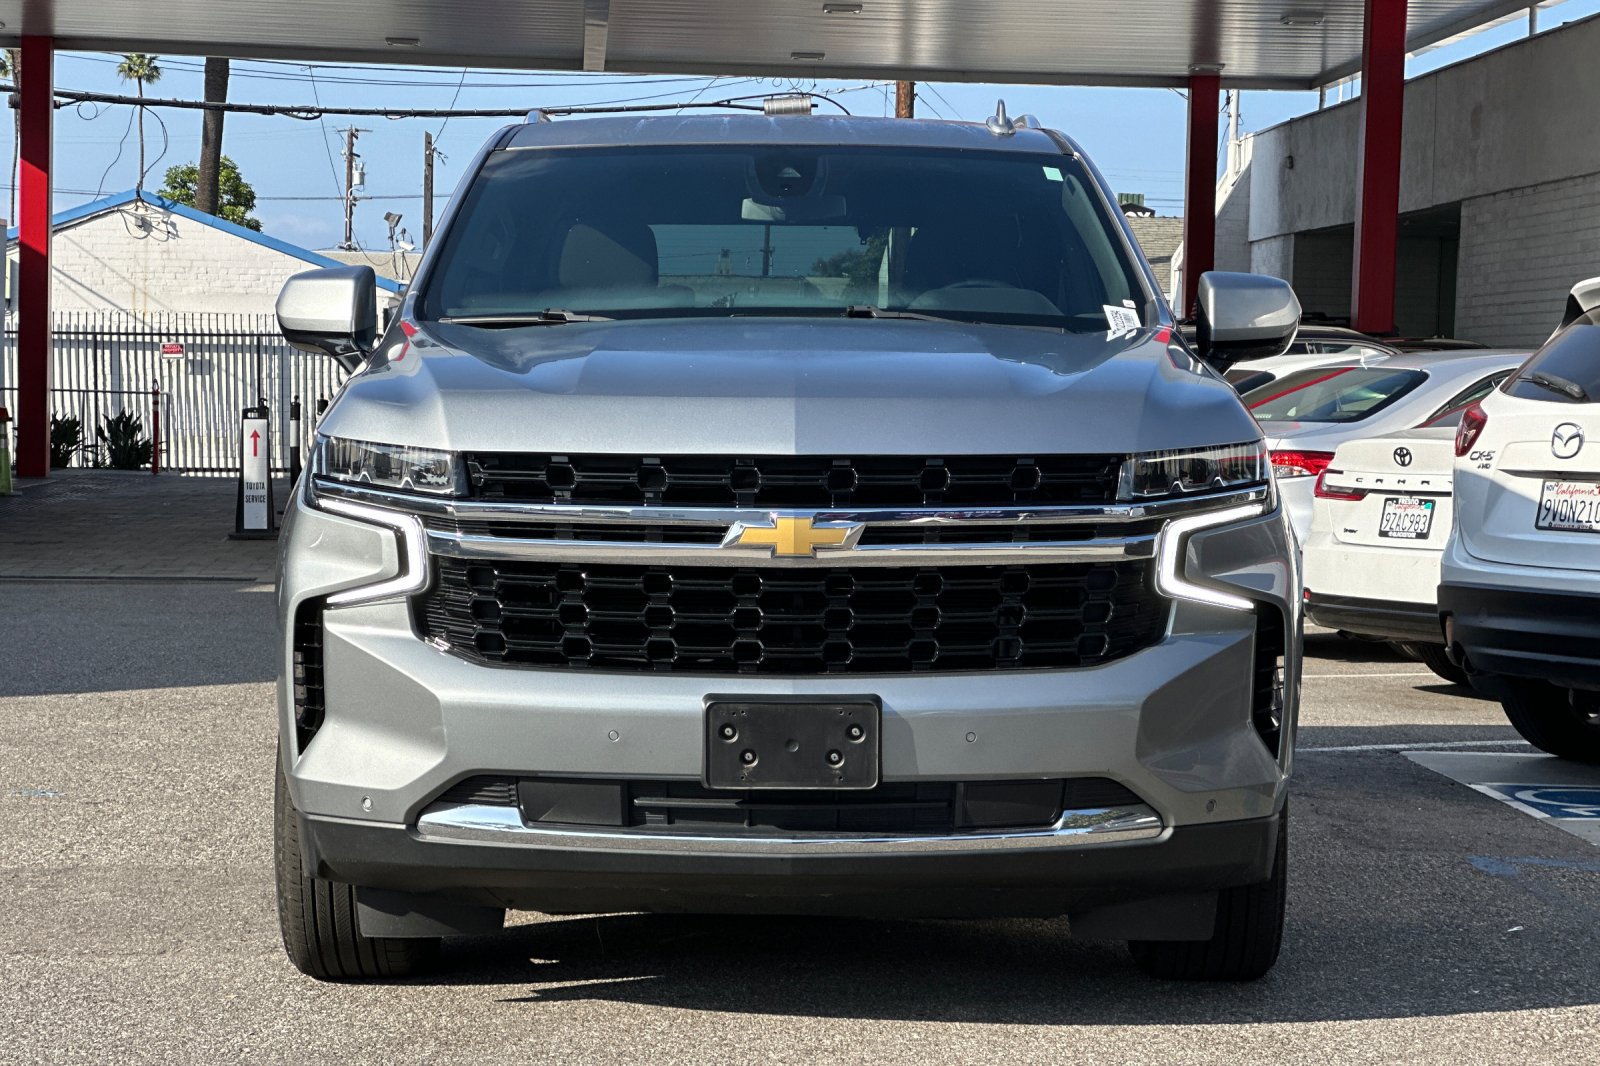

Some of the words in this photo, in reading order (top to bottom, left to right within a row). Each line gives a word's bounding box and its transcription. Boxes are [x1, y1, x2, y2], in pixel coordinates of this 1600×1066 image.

[1469, 450, 1496, 461] CX-5
[246, 482, 265, 490] TOYOTA
[245, 494, 266, 503] SERVICE
[1383, 512, 1428, 532] 9ZAC983
